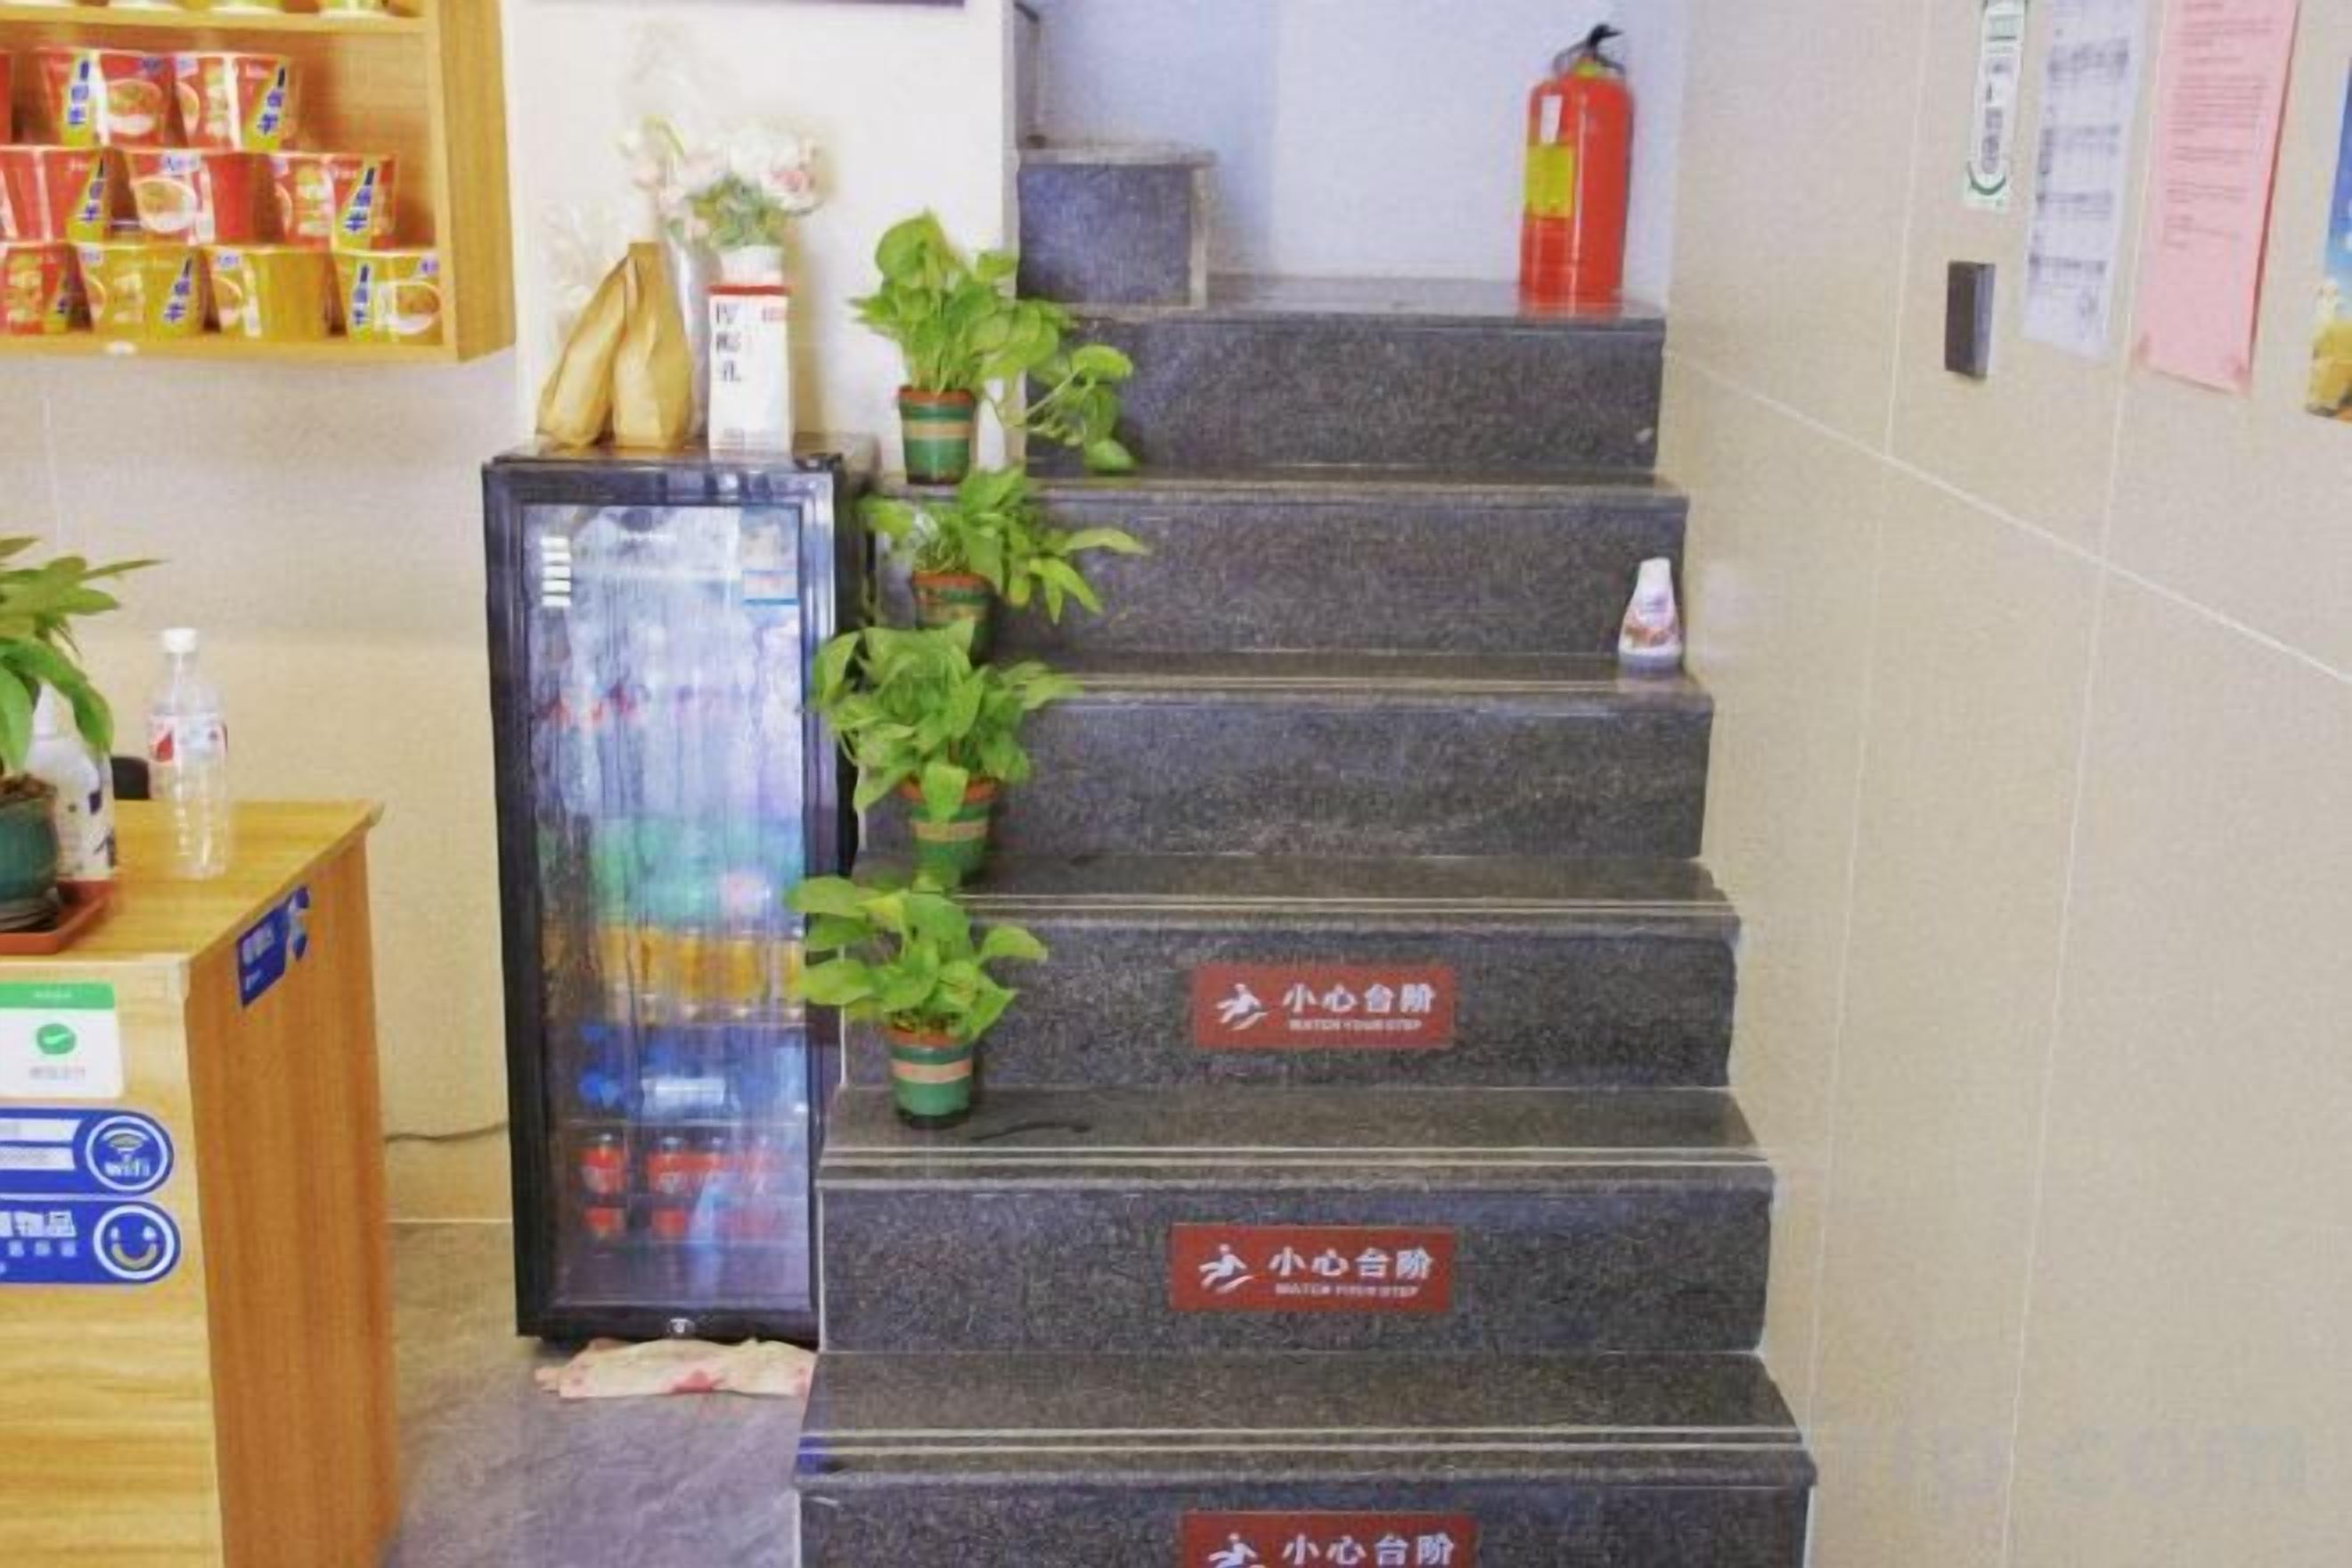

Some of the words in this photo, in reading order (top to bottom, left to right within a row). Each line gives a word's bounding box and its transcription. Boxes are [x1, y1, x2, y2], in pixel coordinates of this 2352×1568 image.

[1282, 983, 1437, 1014] 小心台阶
[1268, 1245, 1433, 1279] 小心台阶
[1281, 1531, 1456, 1566] 小心台阶
